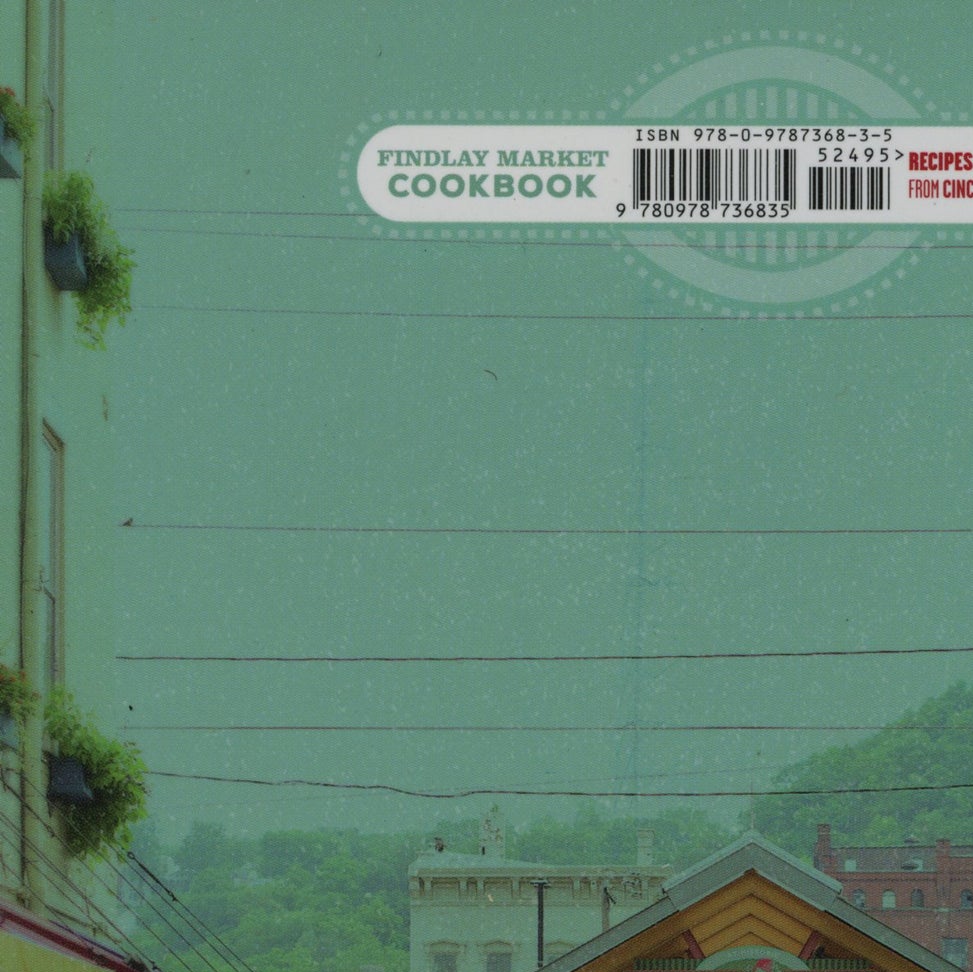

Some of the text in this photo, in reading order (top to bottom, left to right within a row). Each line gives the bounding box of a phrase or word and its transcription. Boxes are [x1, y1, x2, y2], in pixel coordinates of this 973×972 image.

[636, 128, 893, 142] ISBN 978-0-9787368-3-5
[376, 150, 609, 167] FINDLAY MARKET
[387, 173, 598, 198] COOKBOOK
[908, 180, 940, 199] FROM
[615, 203, 791, 218] 9 780978 736835
